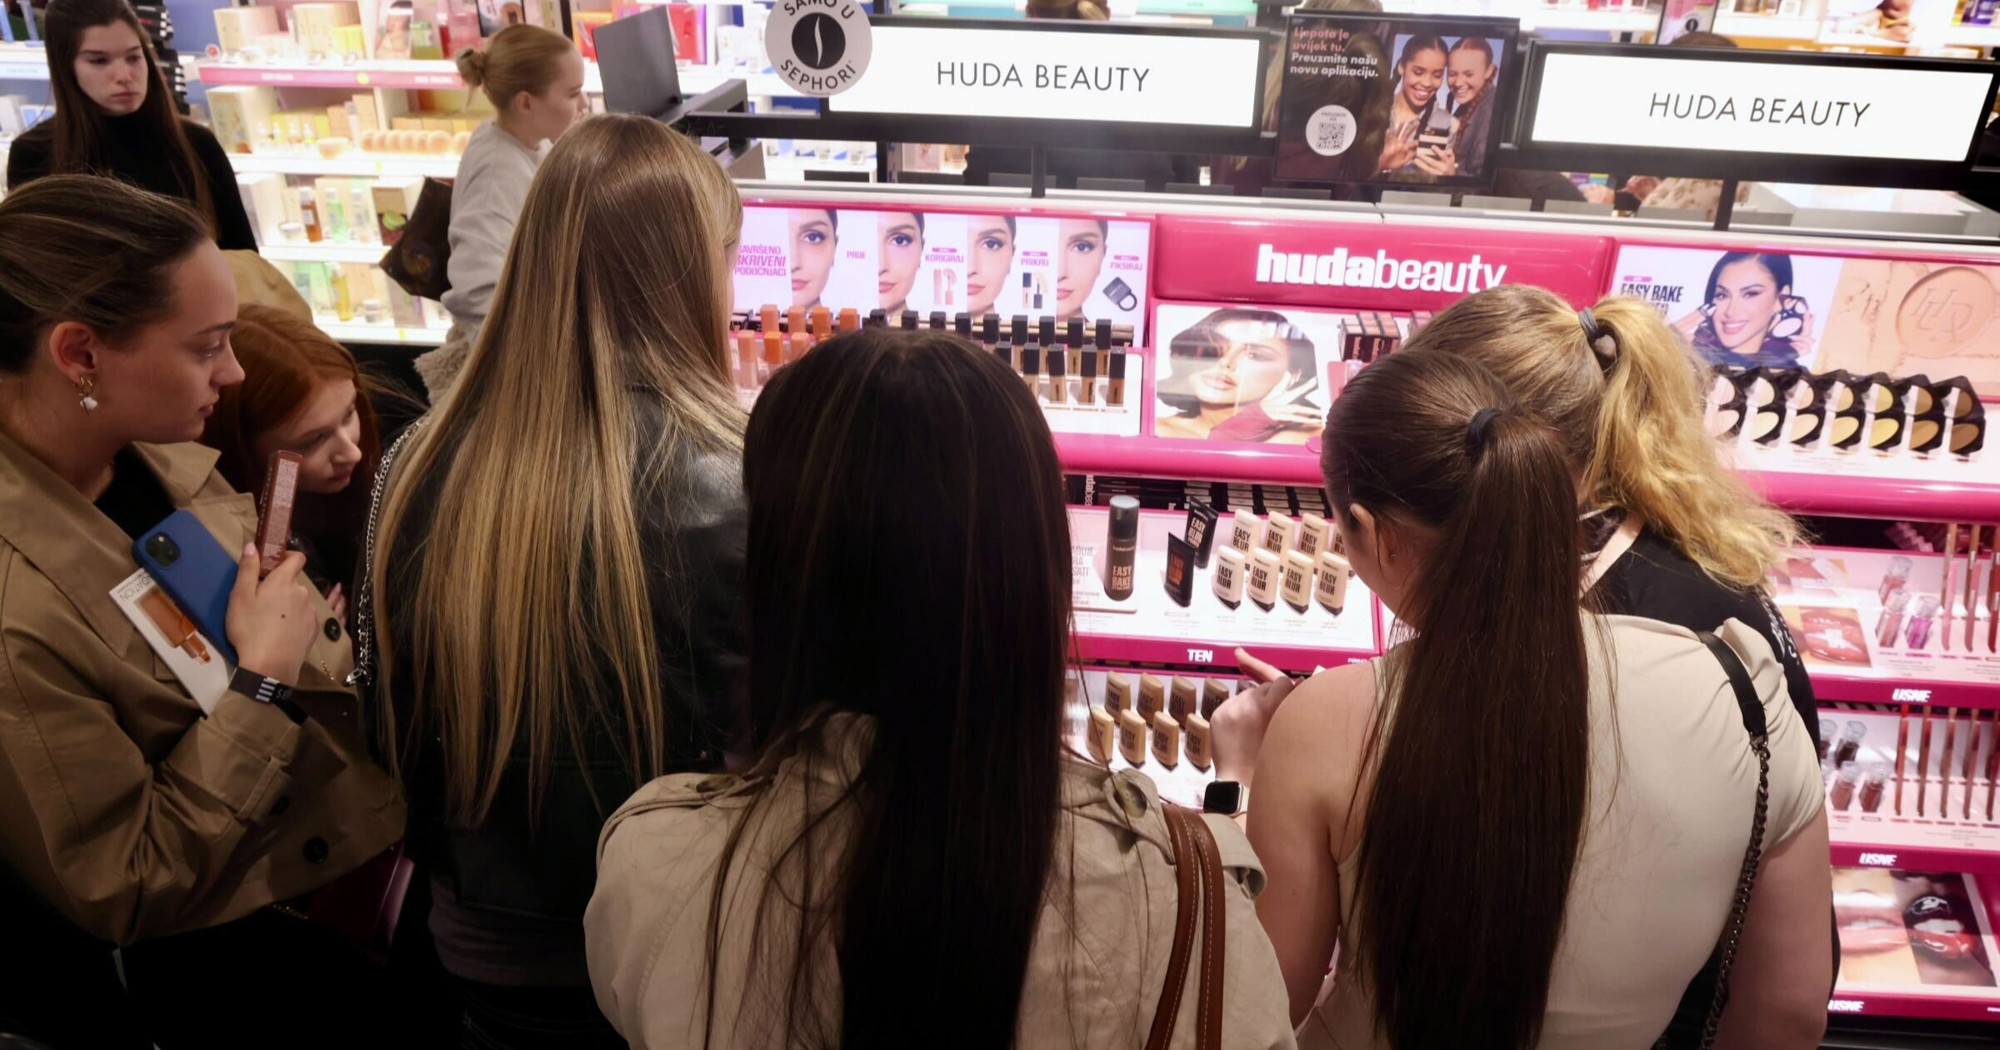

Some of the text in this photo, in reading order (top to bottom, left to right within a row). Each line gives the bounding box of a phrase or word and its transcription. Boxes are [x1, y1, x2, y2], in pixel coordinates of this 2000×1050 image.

[841, 4, 855, 19] U
[1294, 27, 1350, 41] Ljepota je
[1292, 41, 1345, 53] uvijek tu.
[1291, 52, 1378, 65] Preuzmite našu
[780, 59, 856, 90] SEPHORI
[938, 61, 1149, 92] HUDA BEAUTY
[1290, 65, 1379, 79] novu aplikaciju.
[1649, 92, 1871, 128] HUDA BEAUTY
[1651, 285, 1684, 302] BAKE
[1235, 527, 1250, 541] EASY
[1269, 529, 1283, 543] EASY
[1303, 531, 1317, 545] EASY
[1233, 536, 1249, 552] BLUR
[1267, 539, 1282, 553] BLUR
[1301, 541, 1316, 555] BLUR
[1113, 565, 1132, 576] EASY
[1219, 565, 1232, 579] EASY
[1253, 566, 1267, 580] EASY
[1287, 568, 1302, 582] EASY
[1322, 570, 1336, 585] EASY
[1112, 576, 1131, 588] BAKE
[1217, 575, 1231, 589] BLUR
[1251, 577, 1266, 591] BLUR
[1285, 578, 1301, 593] BLUR
[1319, 581, 1335, 595] BLUR
[1187, 649, 1213, 663] TEN
[1892, 688, 1932, 703] USNE
[1859, 852, 1897, 866] USNE
[1827, 1000, 1864, 1012] USNE
